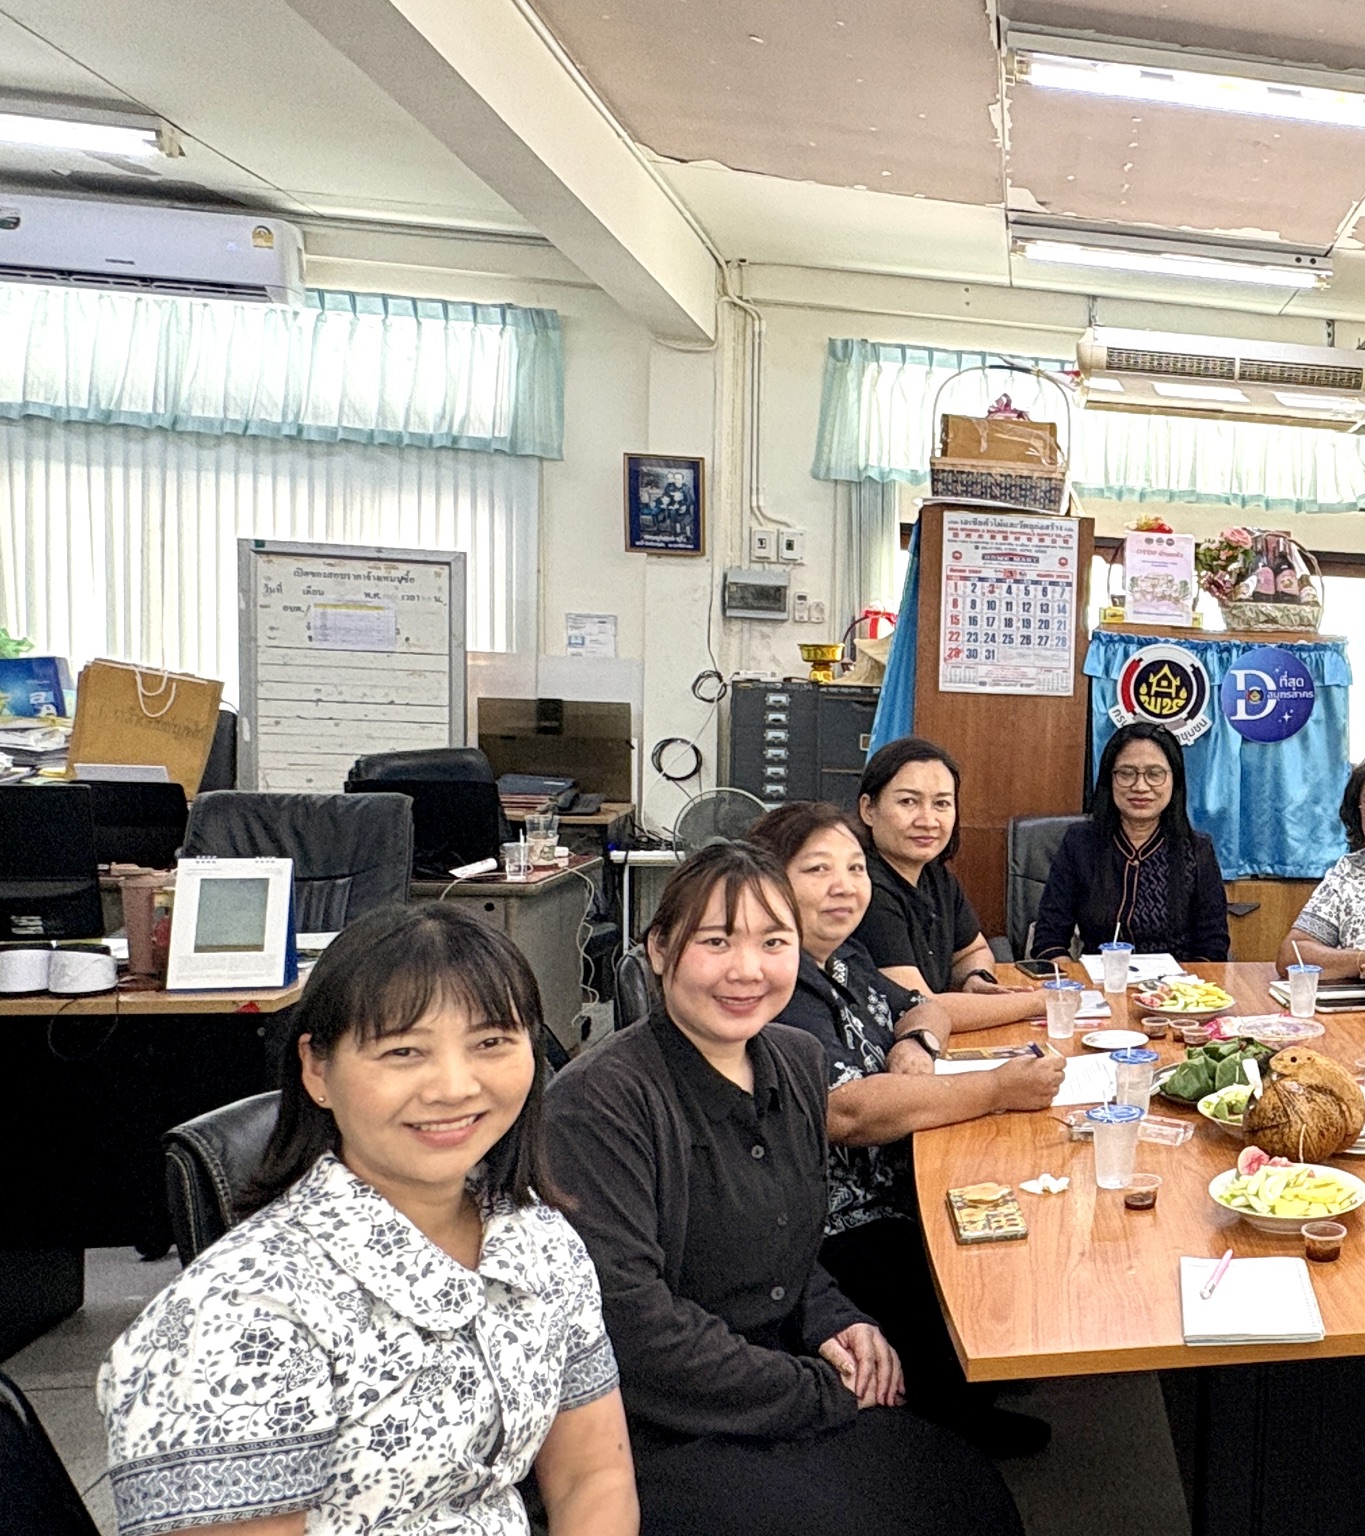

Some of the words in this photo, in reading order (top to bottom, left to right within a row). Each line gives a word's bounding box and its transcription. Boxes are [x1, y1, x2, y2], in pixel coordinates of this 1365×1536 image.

[954, 582, 958, 593] 1
[971, 583, 977, 593] 2
[988, 584, 995, 594] 3
[1006, 585, 1013, 595] 4
[1024, 586, 1030, 596] 5
[1042, 587, 1048, 597] 6
[1059, 588, 1066, 598] 7
[952, 598, 958, 609] 8
[970, 599, 977, 610] 9
[987, 600, 996, 611] 10
[1005, 601, 1013, 612] 11
[1022, 602, 1032, 613] 12
[1040, 603, 1049, 613] 13
[1057, 604, 1067, 614] 14
[950, 615, 960, 625] 15
[968, 616, 978, 626] 16
[986, 617, 996, 627] 17
[1004, 618, 1013, 628] 18
[1022, 619, 1031, 629] 19
[1038, 620, 1049, 630] 20
[1057, 620, 1066, 630] 21
[948, 631, 960, 642] 22
[966, 632, 978, 643] 23
[984, 633, 996, 643] 24
[1002, 634, 1014, 644] 25
[1020, 635, 1031, 645] 26
[1038, 636, 1049, 646] 27
[1055, 636, 1067, 647] 28
[966, 648, 978, 659] 30
[985, 649, 995, 660] 31
[1279, 671, 1304, 690] ที่สุด
[1267, 690, 1314, 701] สมุทรสาคร
